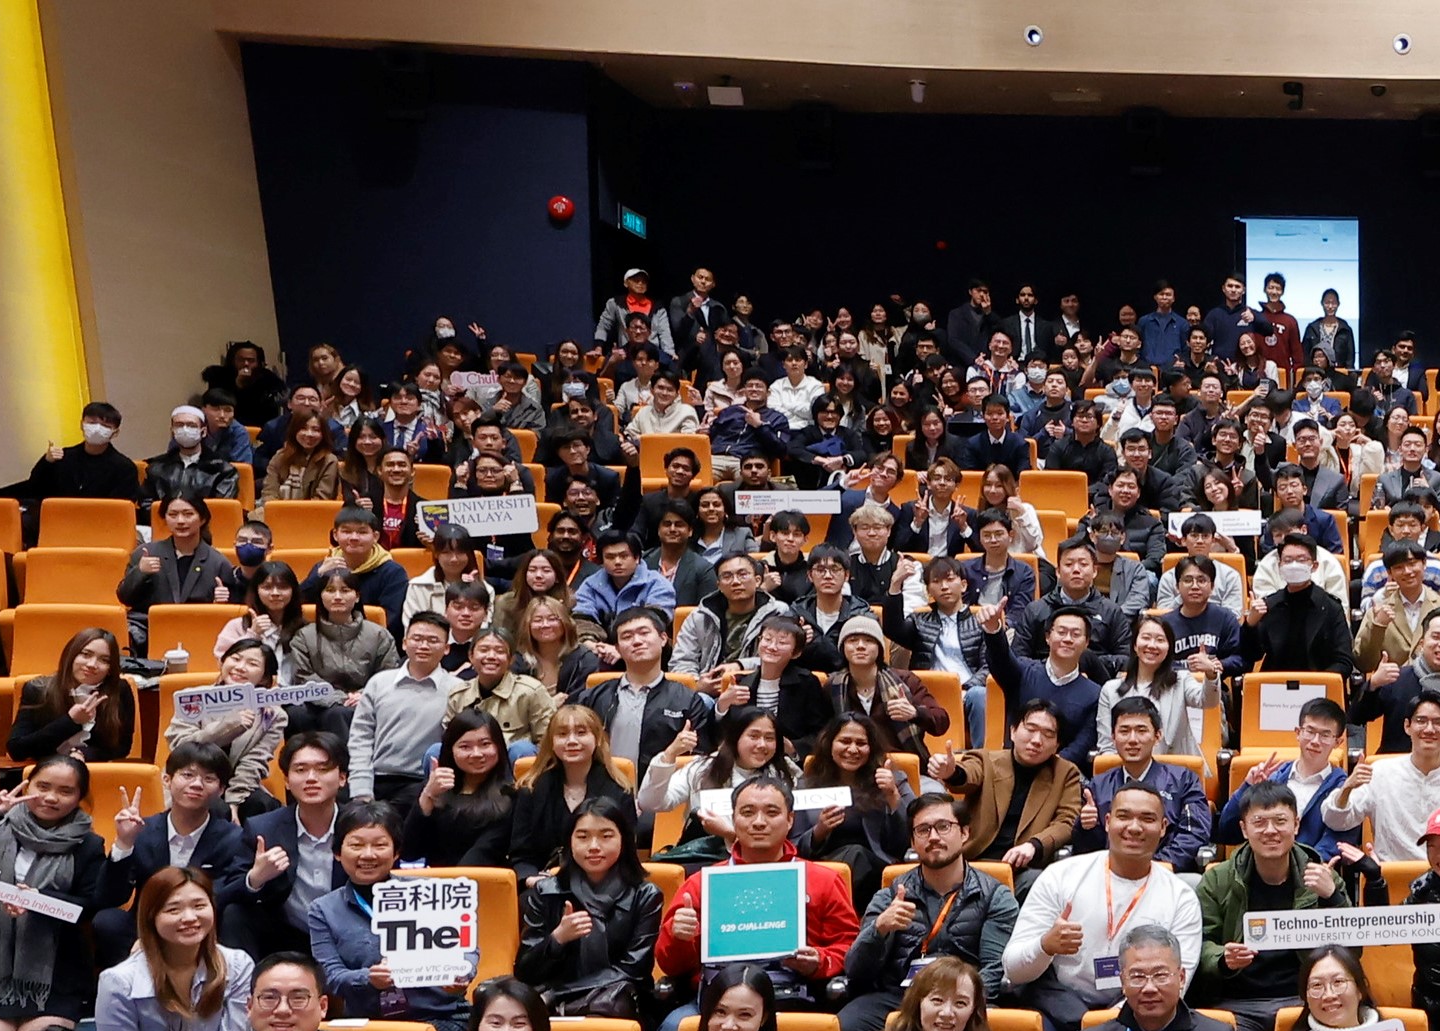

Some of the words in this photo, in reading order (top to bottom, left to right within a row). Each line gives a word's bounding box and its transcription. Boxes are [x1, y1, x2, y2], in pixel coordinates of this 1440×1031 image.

[451, 497, 531, 513] UNIVERSITI
[452, 510, 513, 524] MALAYA
[1174, 633, 1220, 654] OLUMBI
[204, 688, 245, 704] NUS
[256, 685, 330, 705] Enterprise
[377, 882, 472, 913] 高科院
[31, 899, 75, 920] Initiative
[720, 923, 737, 933] 929
[737, 920, 787, 931] CHALLENGE
[1272, 911, 1436, 931] Techno-Entrepreneurship
[376, 913, 471, 952] Thei
[1273, 933, 1292, 944] THE
[1295, 930, 1352, 943] UNIVERSITY
[1357, 930, 1371, 940] OF
[1374, 929, 1408, 940] HONG
